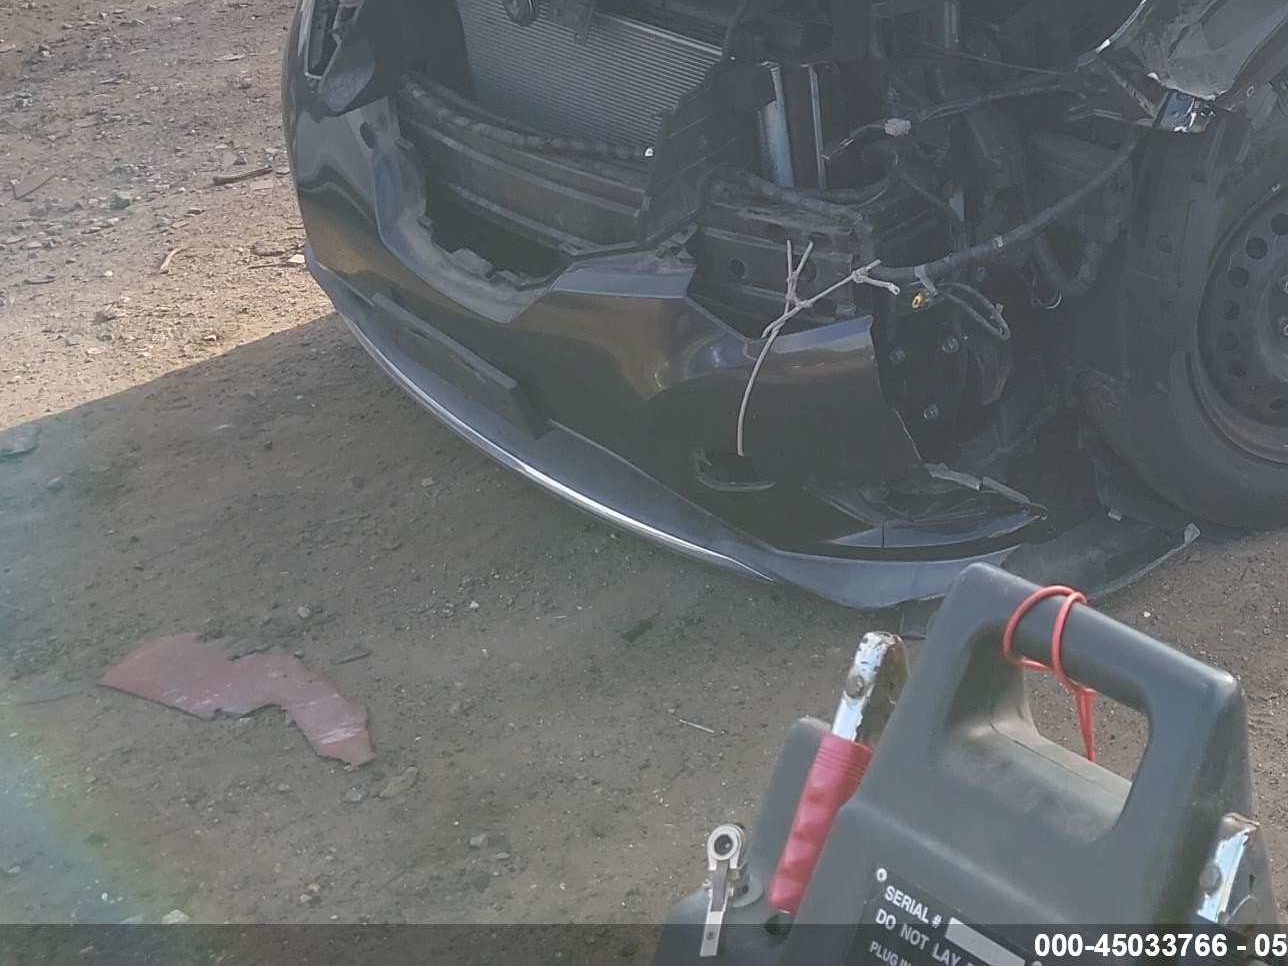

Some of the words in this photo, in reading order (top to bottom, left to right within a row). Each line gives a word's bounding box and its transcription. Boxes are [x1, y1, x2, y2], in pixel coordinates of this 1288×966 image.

[884, 885, 930, 924] SERIAL
[931, 914, 942, 929] #
[870, 941, 898, 966] PLUG
[875, 908, 897, 930] DO
[899, 922, 930, 951] NOT
[932, 943, 961, 966] LAY
